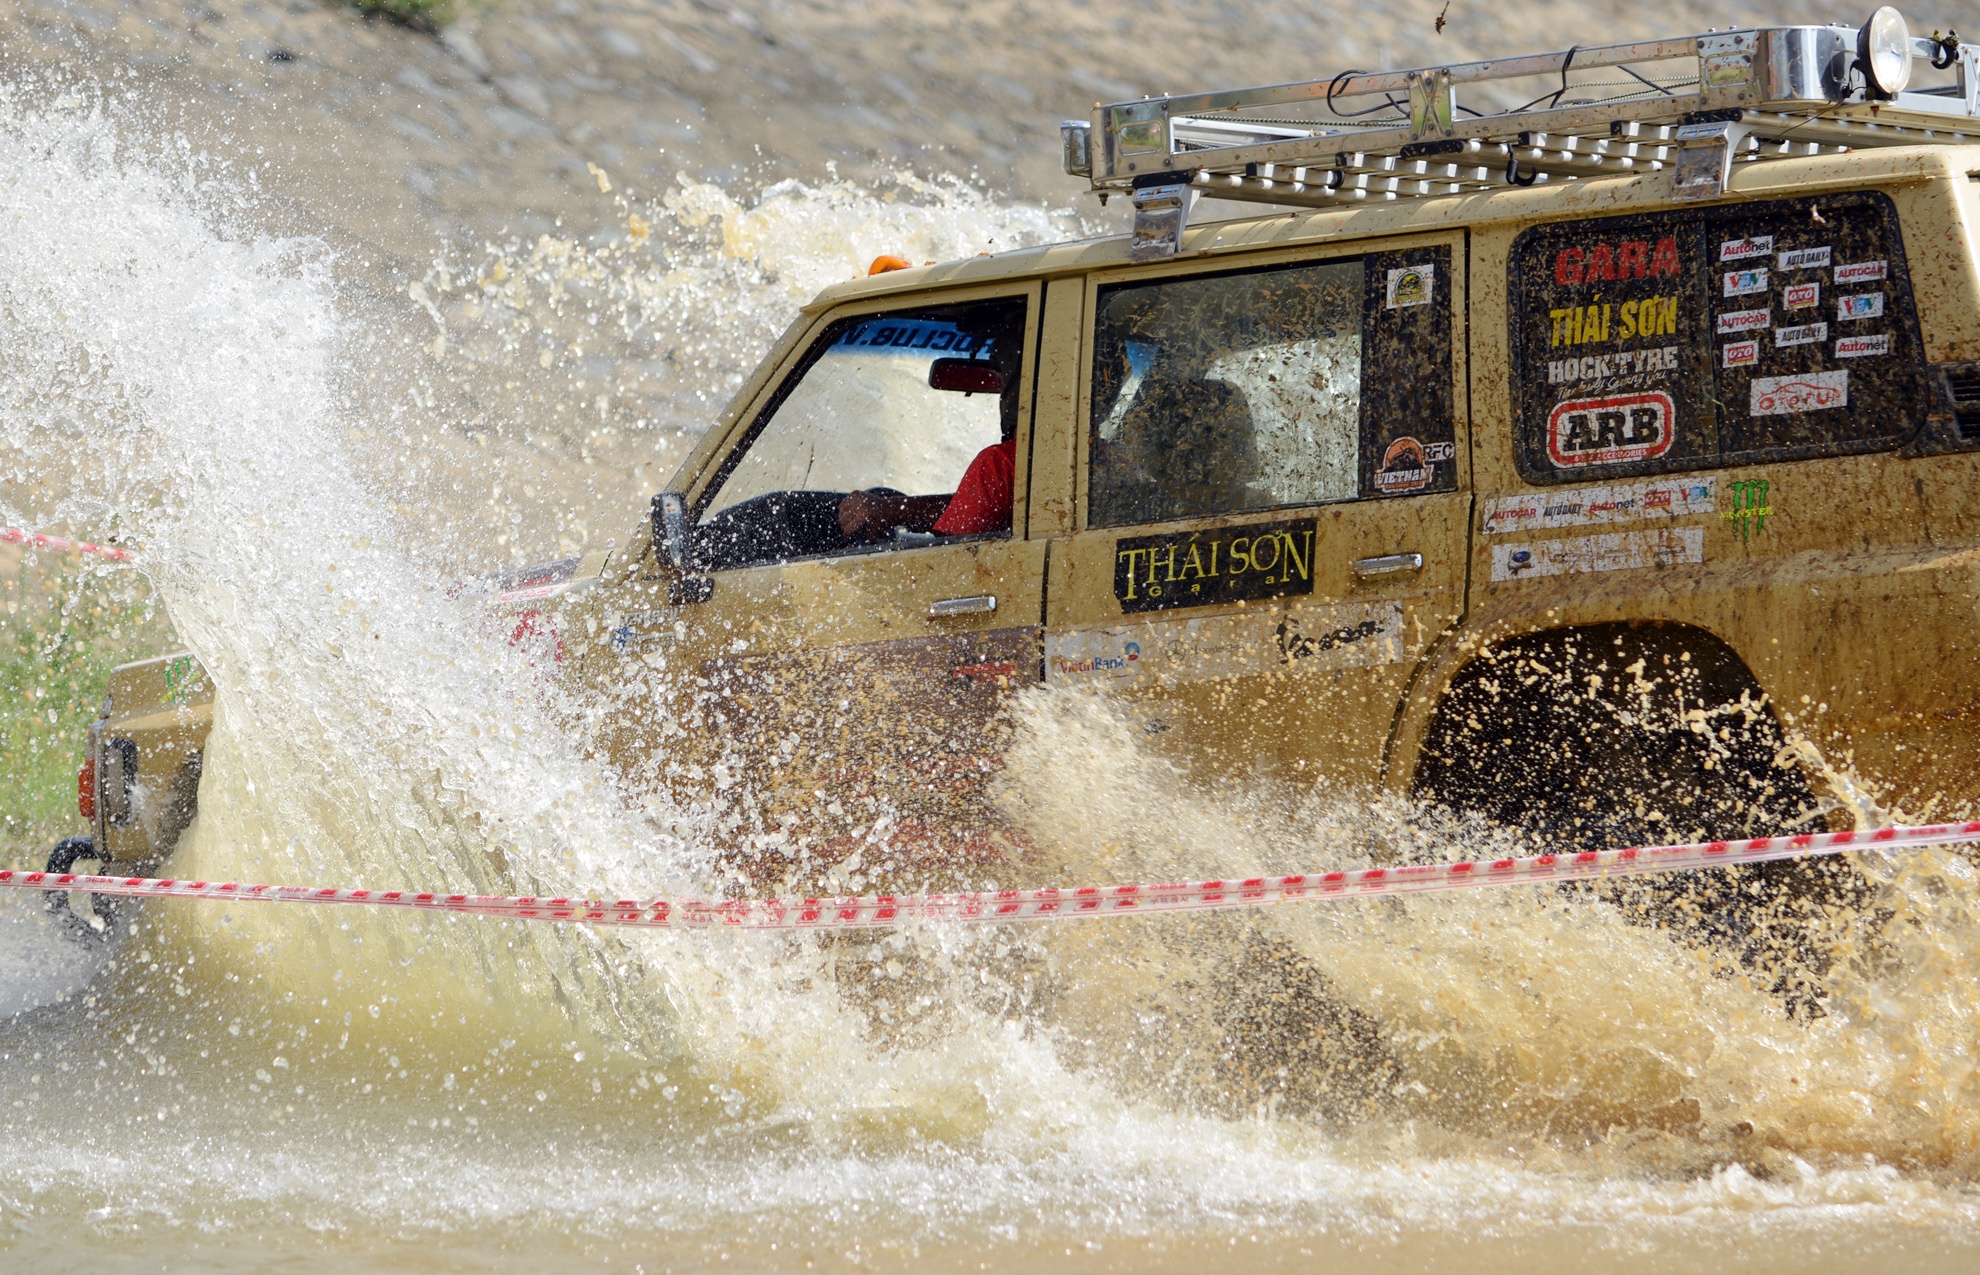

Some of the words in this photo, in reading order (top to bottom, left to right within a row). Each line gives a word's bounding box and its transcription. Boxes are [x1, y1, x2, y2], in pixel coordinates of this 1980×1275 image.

[1723, 241, 1770, 256] Autonet
[1555, 237, 1680, 287] GARA
[1786, 252, 1805, 267] AUTO
[1837, 266, 1884, 279] AUTOCAR
[1550, 293, 1611, 347] THÁI
[1619, 294, 1678, 339] SƠN
[1721, 313, 1767, 327] AUTOCAR
[1838, 341, 1885, 353] Autonet
[1562, 407, 1660, 452] ARB
[1423, 443, 1453, 459] RFC
[1377, 467, 1430, 485] VIETNAM
[1491, 507, 1537, 520] AUTOCAR
[1589, 499, 1635, 513] Autonet
[1119, 532, 1220, 600] THÁI
[1229, 529, 1314, 582] SƠN
